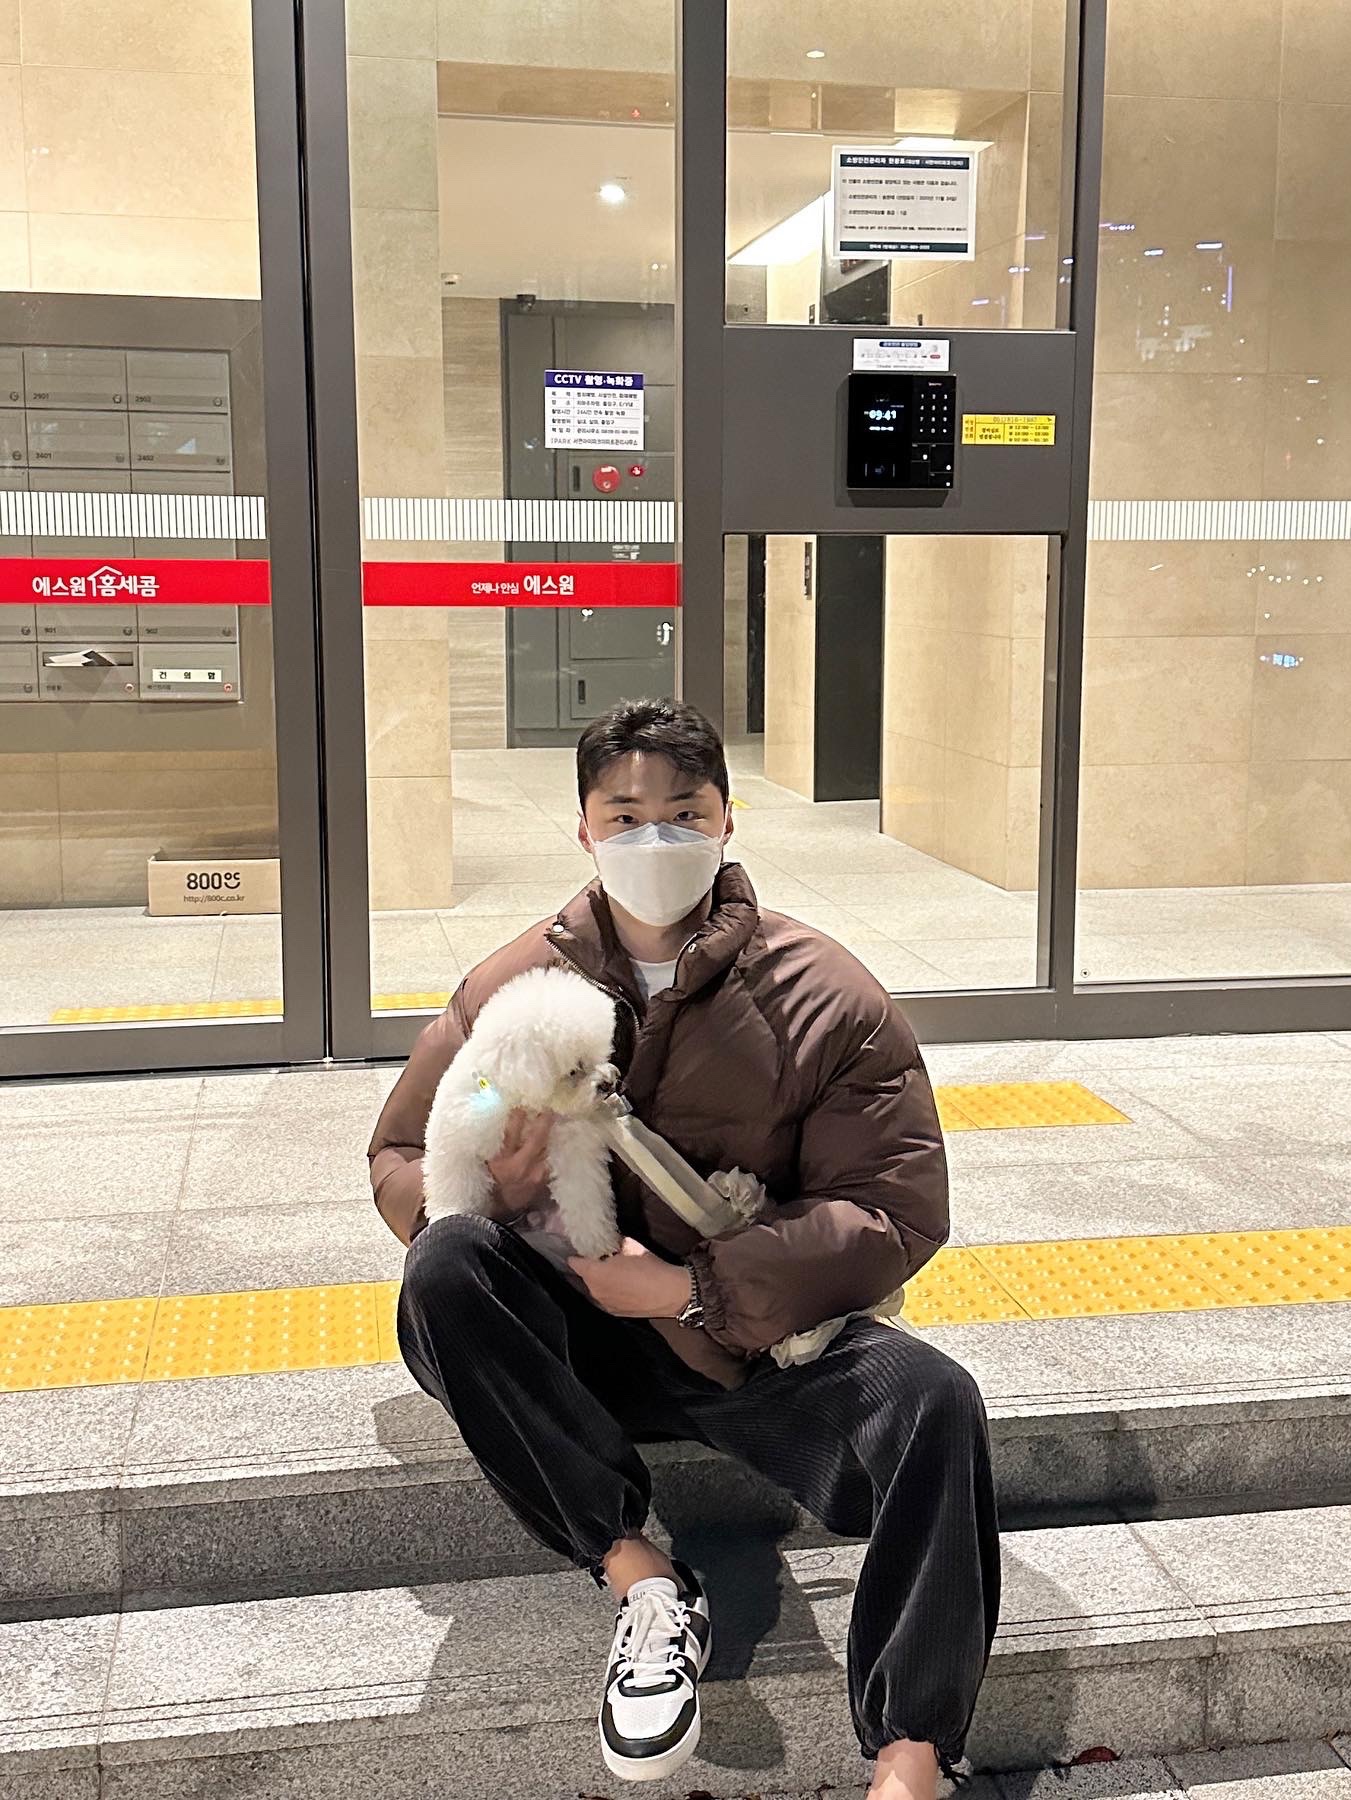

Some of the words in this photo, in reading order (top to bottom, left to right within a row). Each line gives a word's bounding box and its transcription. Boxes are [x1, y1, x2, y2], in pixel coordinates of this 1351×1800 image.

[553, 373, 582, 385] CCTV
[32, 576, 86, 597] 에스원
[97, 575, 160, 598] 홈세콤
[471, 582, 500, 594] 언제나
[500, 582, 520, 595] 안심
[523, 575, 575, 596] 에스원
